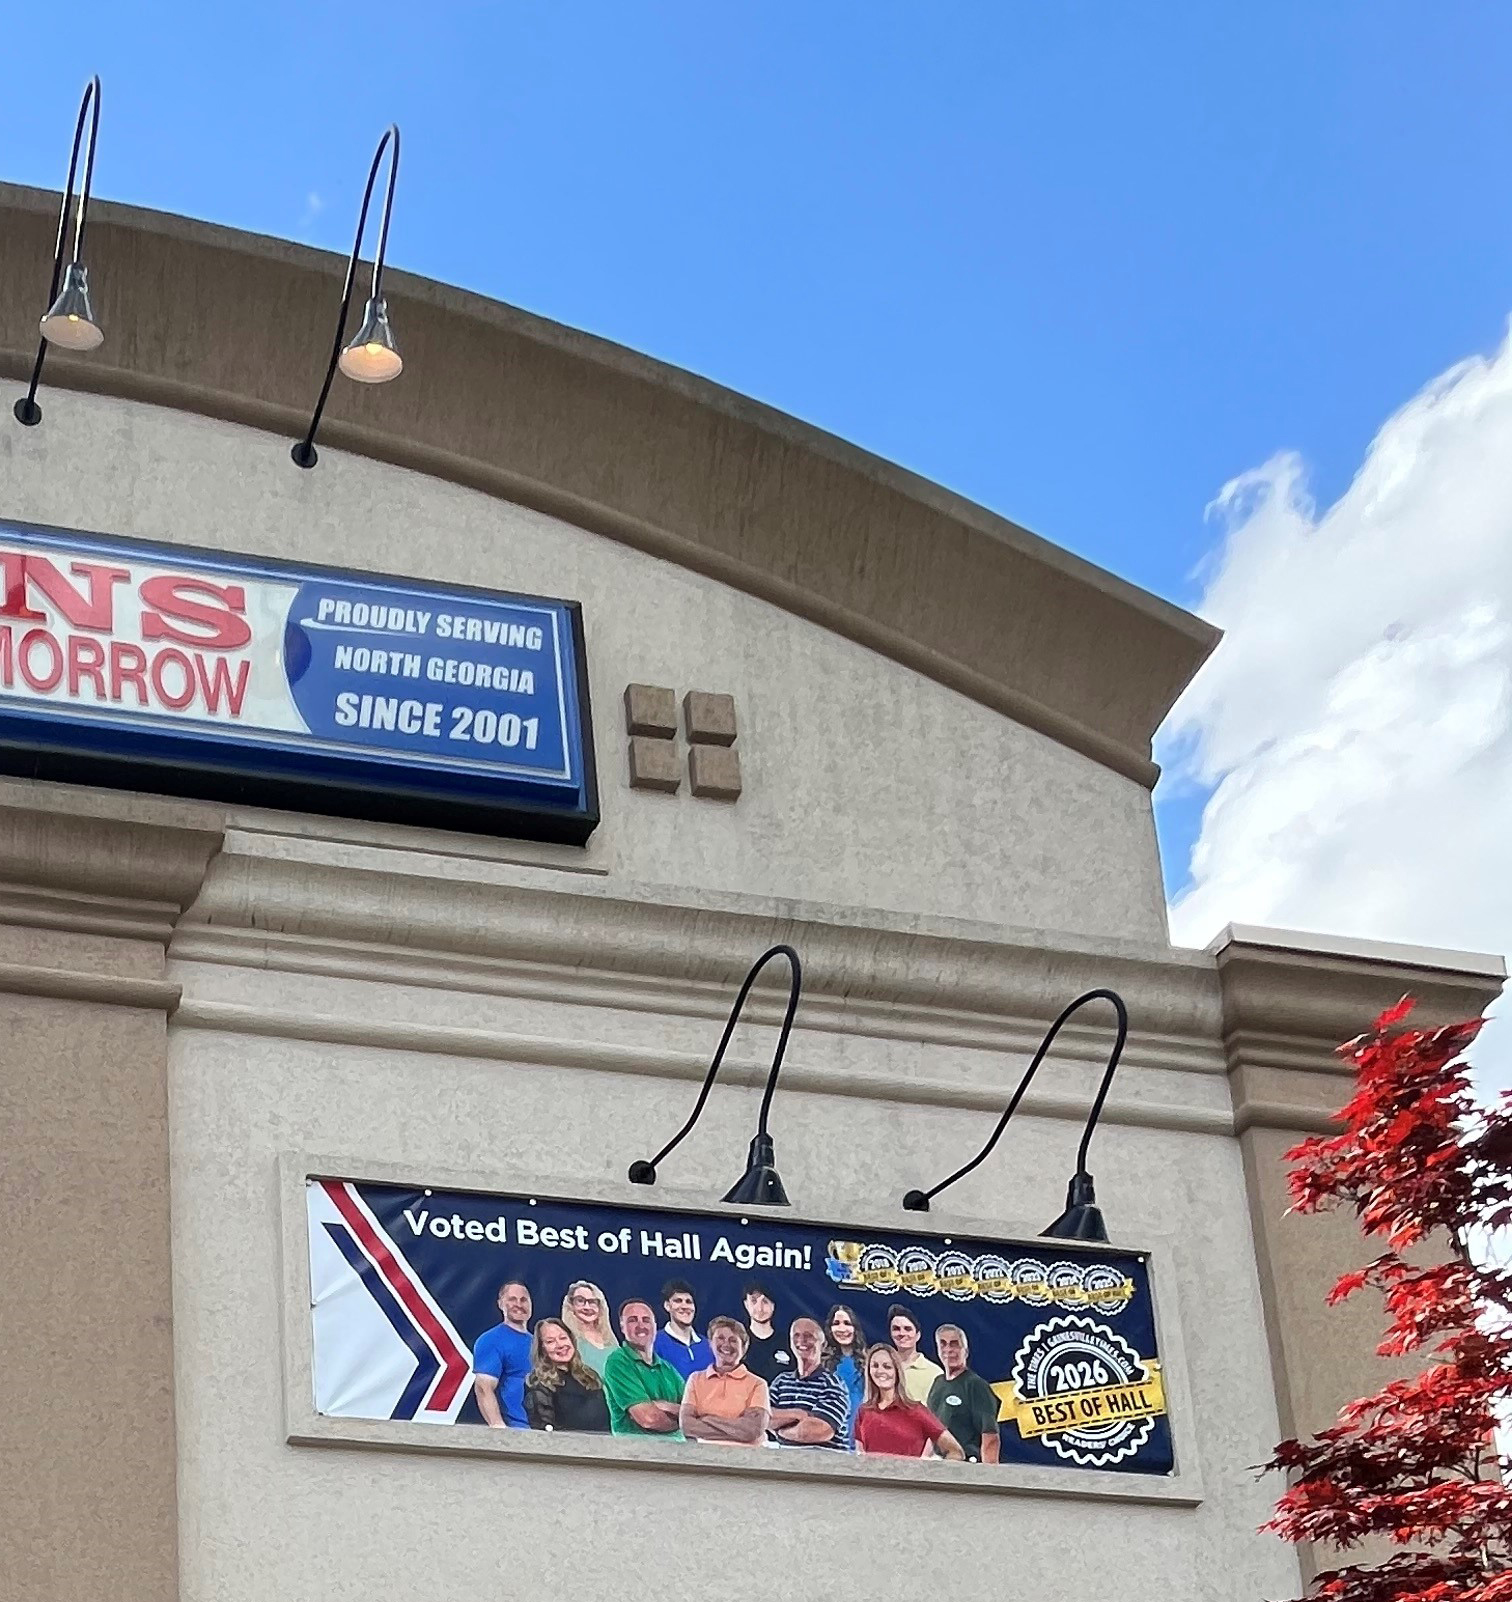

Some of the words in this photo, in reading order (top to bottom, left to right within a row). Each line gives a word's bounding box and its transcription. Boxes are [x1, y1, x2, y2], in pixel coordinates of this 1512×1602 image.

[317, 598, 432, 634] PROUDLY
[436, 614, 543, 651] SERVING
[334, 645, 421, 678] NORTH
[426, 656, 534, 695] GEORGIA
[335, 692, 443, 738] SINCE
[449, 706, 539, 750] 2001
[403, 1208, 506, 1243] Voted
[515, 1218, 589, 1251] Best
[597, 1227, 633, 1254] of
[641, 1230, 701, 1260] Hall
[710, 1236, 812, 1271] Again!
[1050, 1359, 1109, 1391] 2026
[1032, 1401, 1076, 1426] BEST
[1080, 1396, 1103, 1417] OF
[1106, 1390, 1153, 1413] HALL
